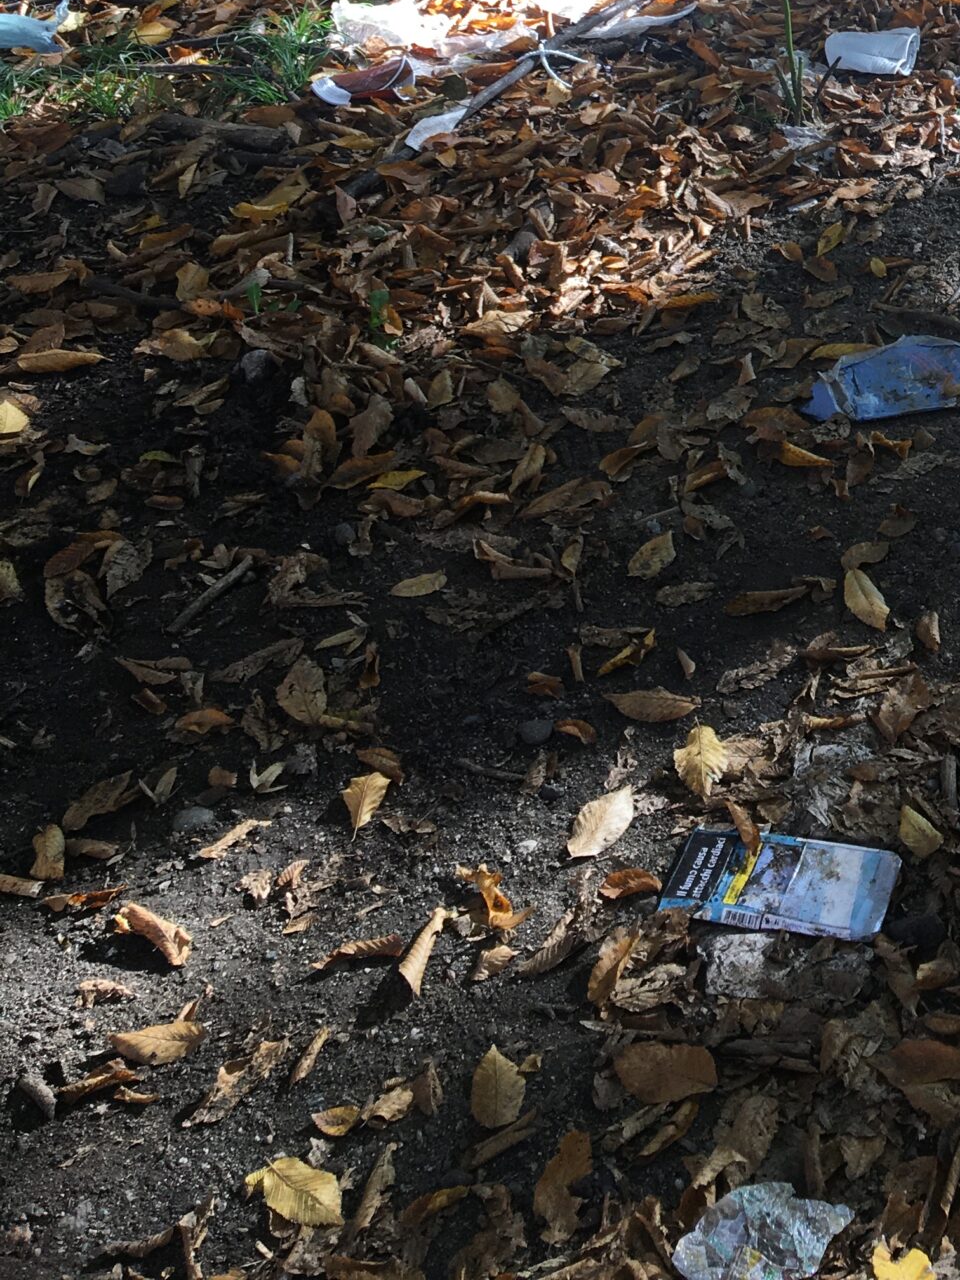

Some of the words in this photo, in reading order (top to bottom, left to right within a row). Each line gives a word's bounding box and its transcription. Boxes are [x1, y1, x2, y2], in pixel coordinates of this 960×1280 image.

[692, 847, 709, 869] causa
[692, 868, 713, 898] attacchi
[707, 837, 727, 868] cardiaci
